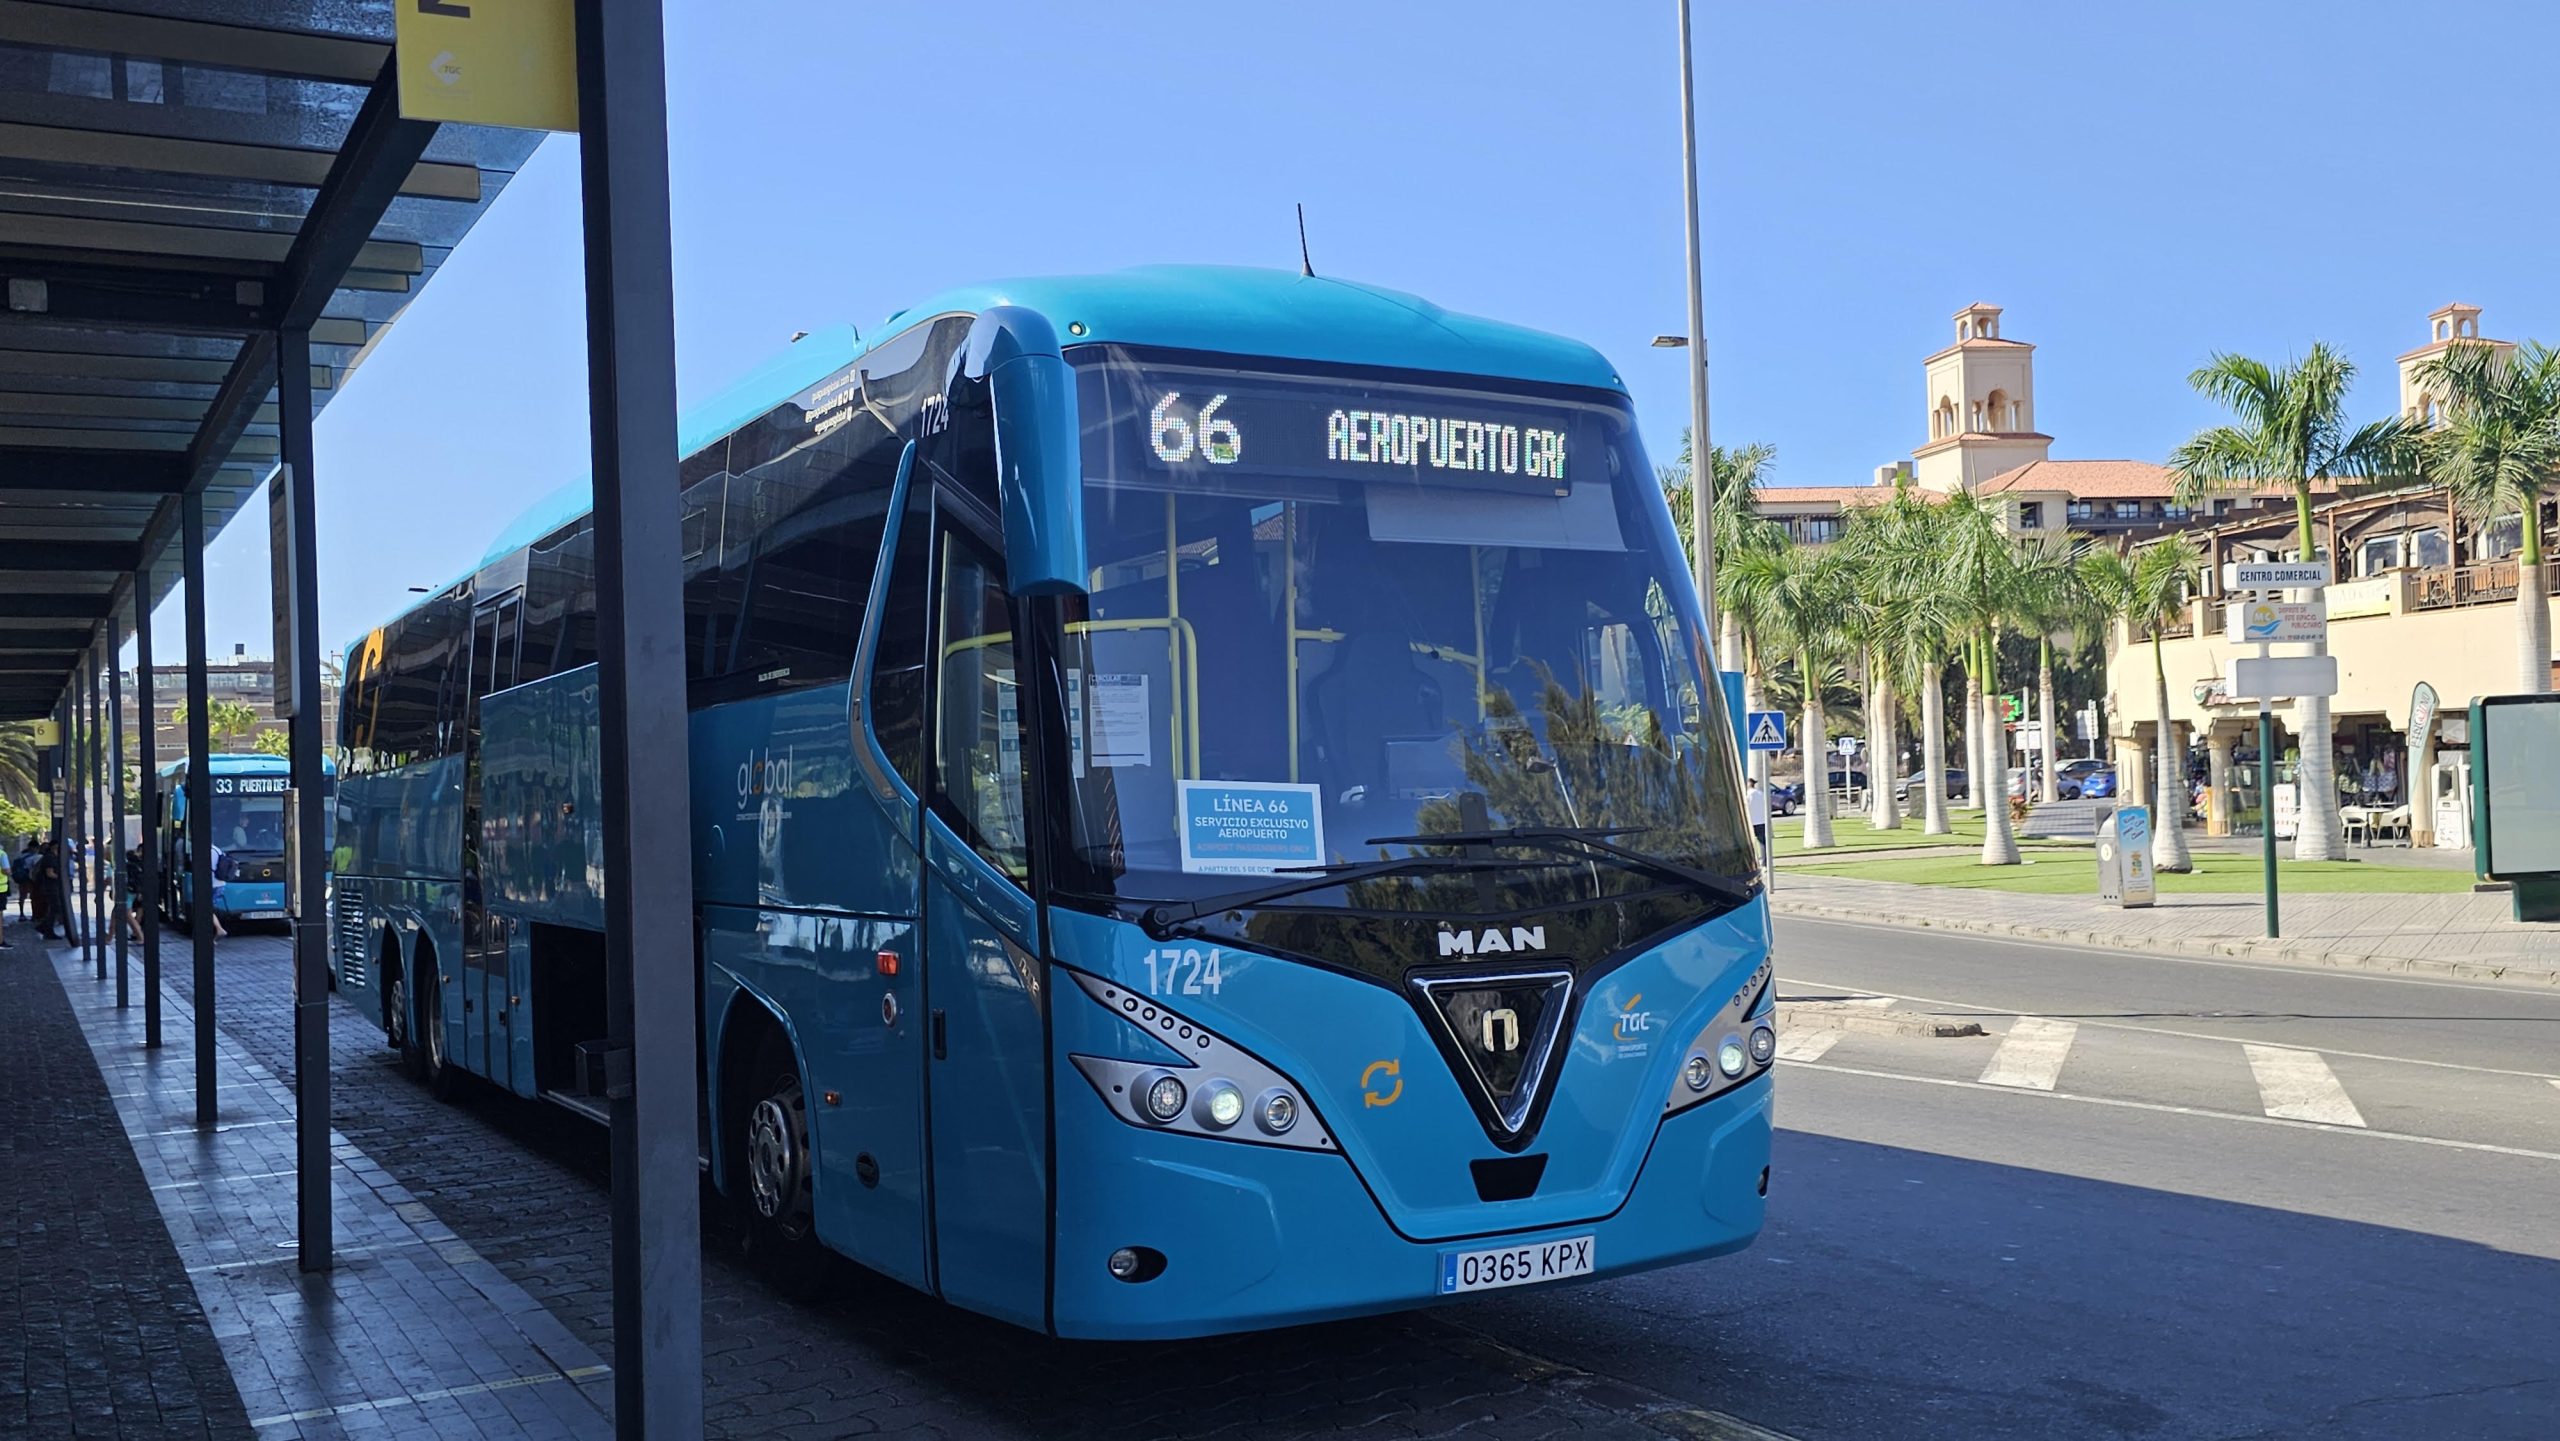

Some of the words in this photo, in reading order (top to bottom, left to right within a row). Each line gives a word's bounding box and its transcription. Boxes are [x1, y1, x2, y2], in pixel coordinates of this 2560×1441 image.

[920, 392, 950, 438] 1724
[1151, 392, 1241, 465] 66
[1328, 409, 1518, 474] AEROPUERTO
[2240, 570, 2273, 582] CENTRO
[2275, 569, 2322, 581] COMERCIAL
[36, 726, 45, 736] 6
[215, 778, 233, 794] 33
[239, 778, 273, 793] PUERTO
[273, 778, 285, 792] DE
[1213, 793, 1265, 813] LÍNEA
[1268, 799, 1289, 814] 66
[1194, 816, 1248, 828] SERVICIO
[1250, 817, 1309, 829] EXCLUSIVO
[1218, 828, 1288, 839] AEROPUERTO
[1204, 865, 1229, 873] PARTIR
[1438, 926, 1546, 956] MAN
[1143, 947, 1222, 996] 1724
[1620, 1012, 1651, 1033] TGC
[1446, 1276, 1454, 1286] E
[1463, 1250, 1532, 1286] 0365
[1541, 1240, 1589, 1277] KPX
